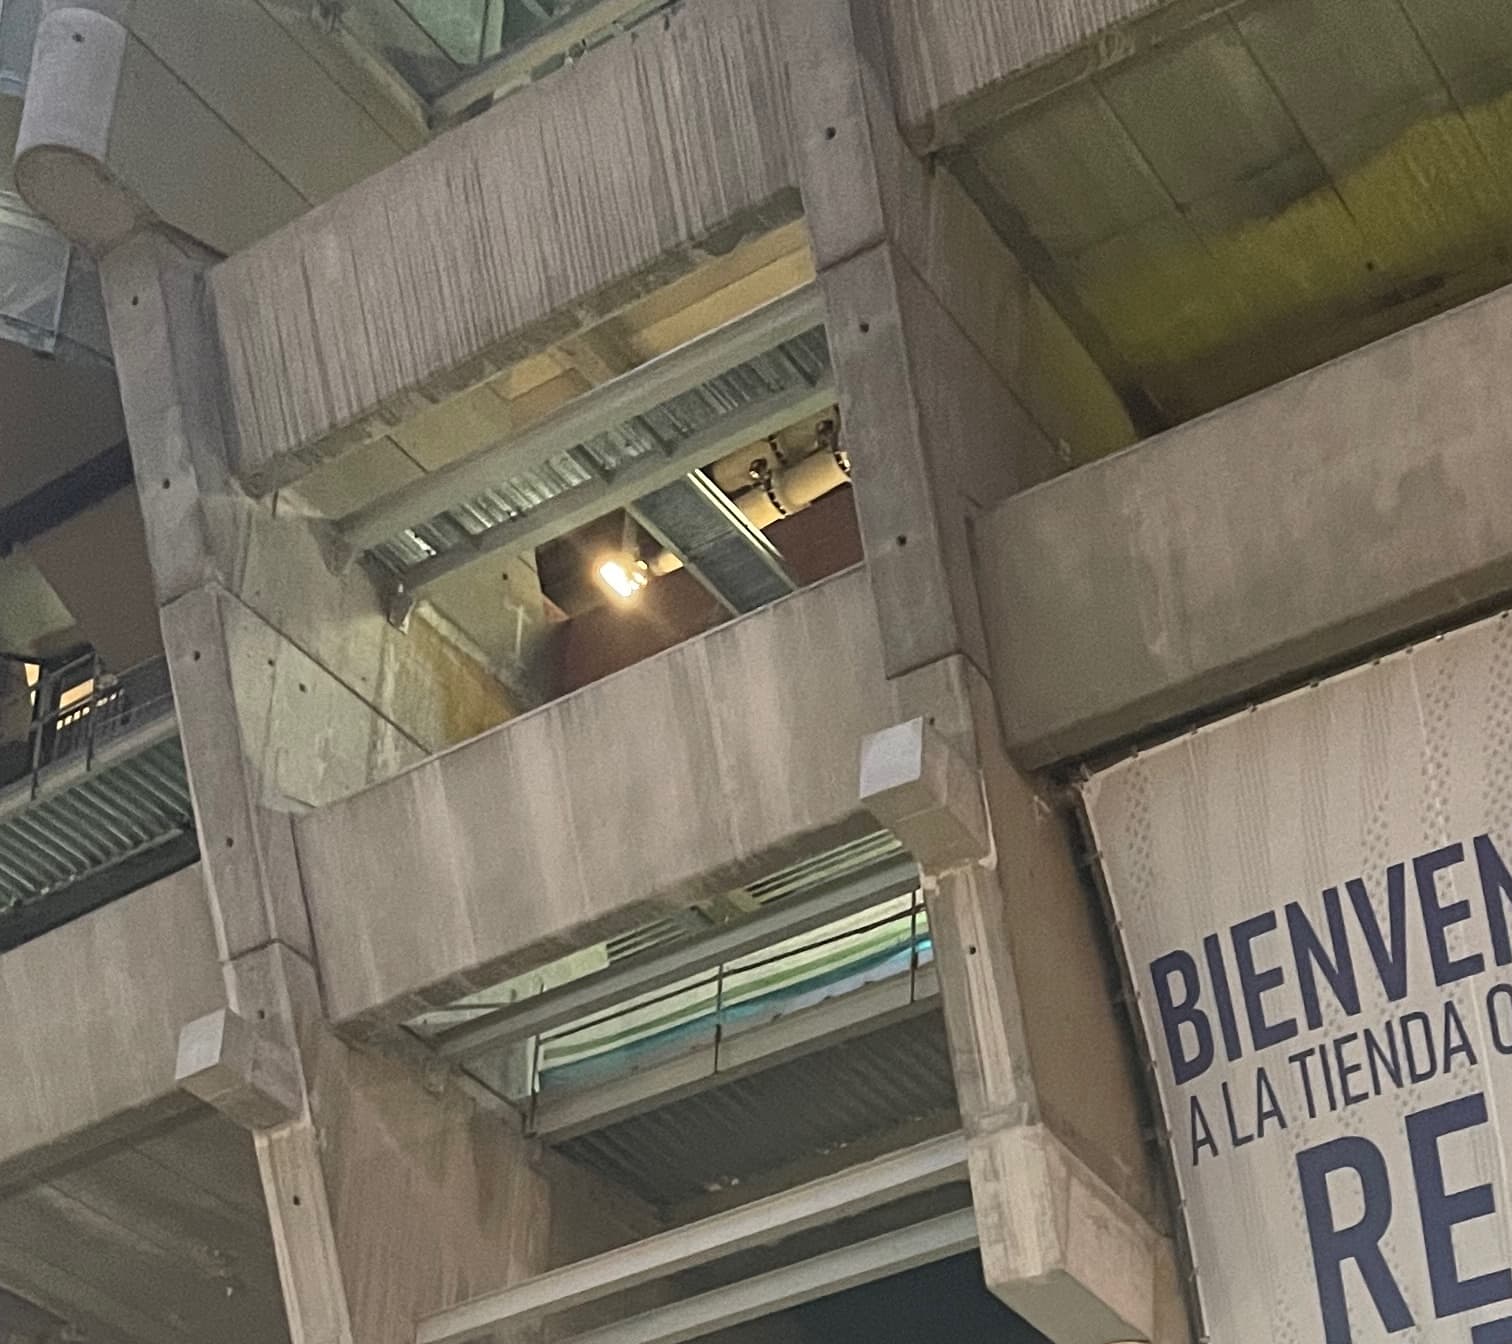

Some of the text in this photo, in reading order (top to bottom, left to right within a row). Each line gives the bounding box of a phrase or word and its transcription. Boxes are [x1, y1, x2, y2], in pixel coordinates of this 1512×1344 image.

[1191, 1094, 1220, 1166] A
[1221, 1066, 1288, 1149] LA
[1288, 1000, 1478, 1121] TIENDA
